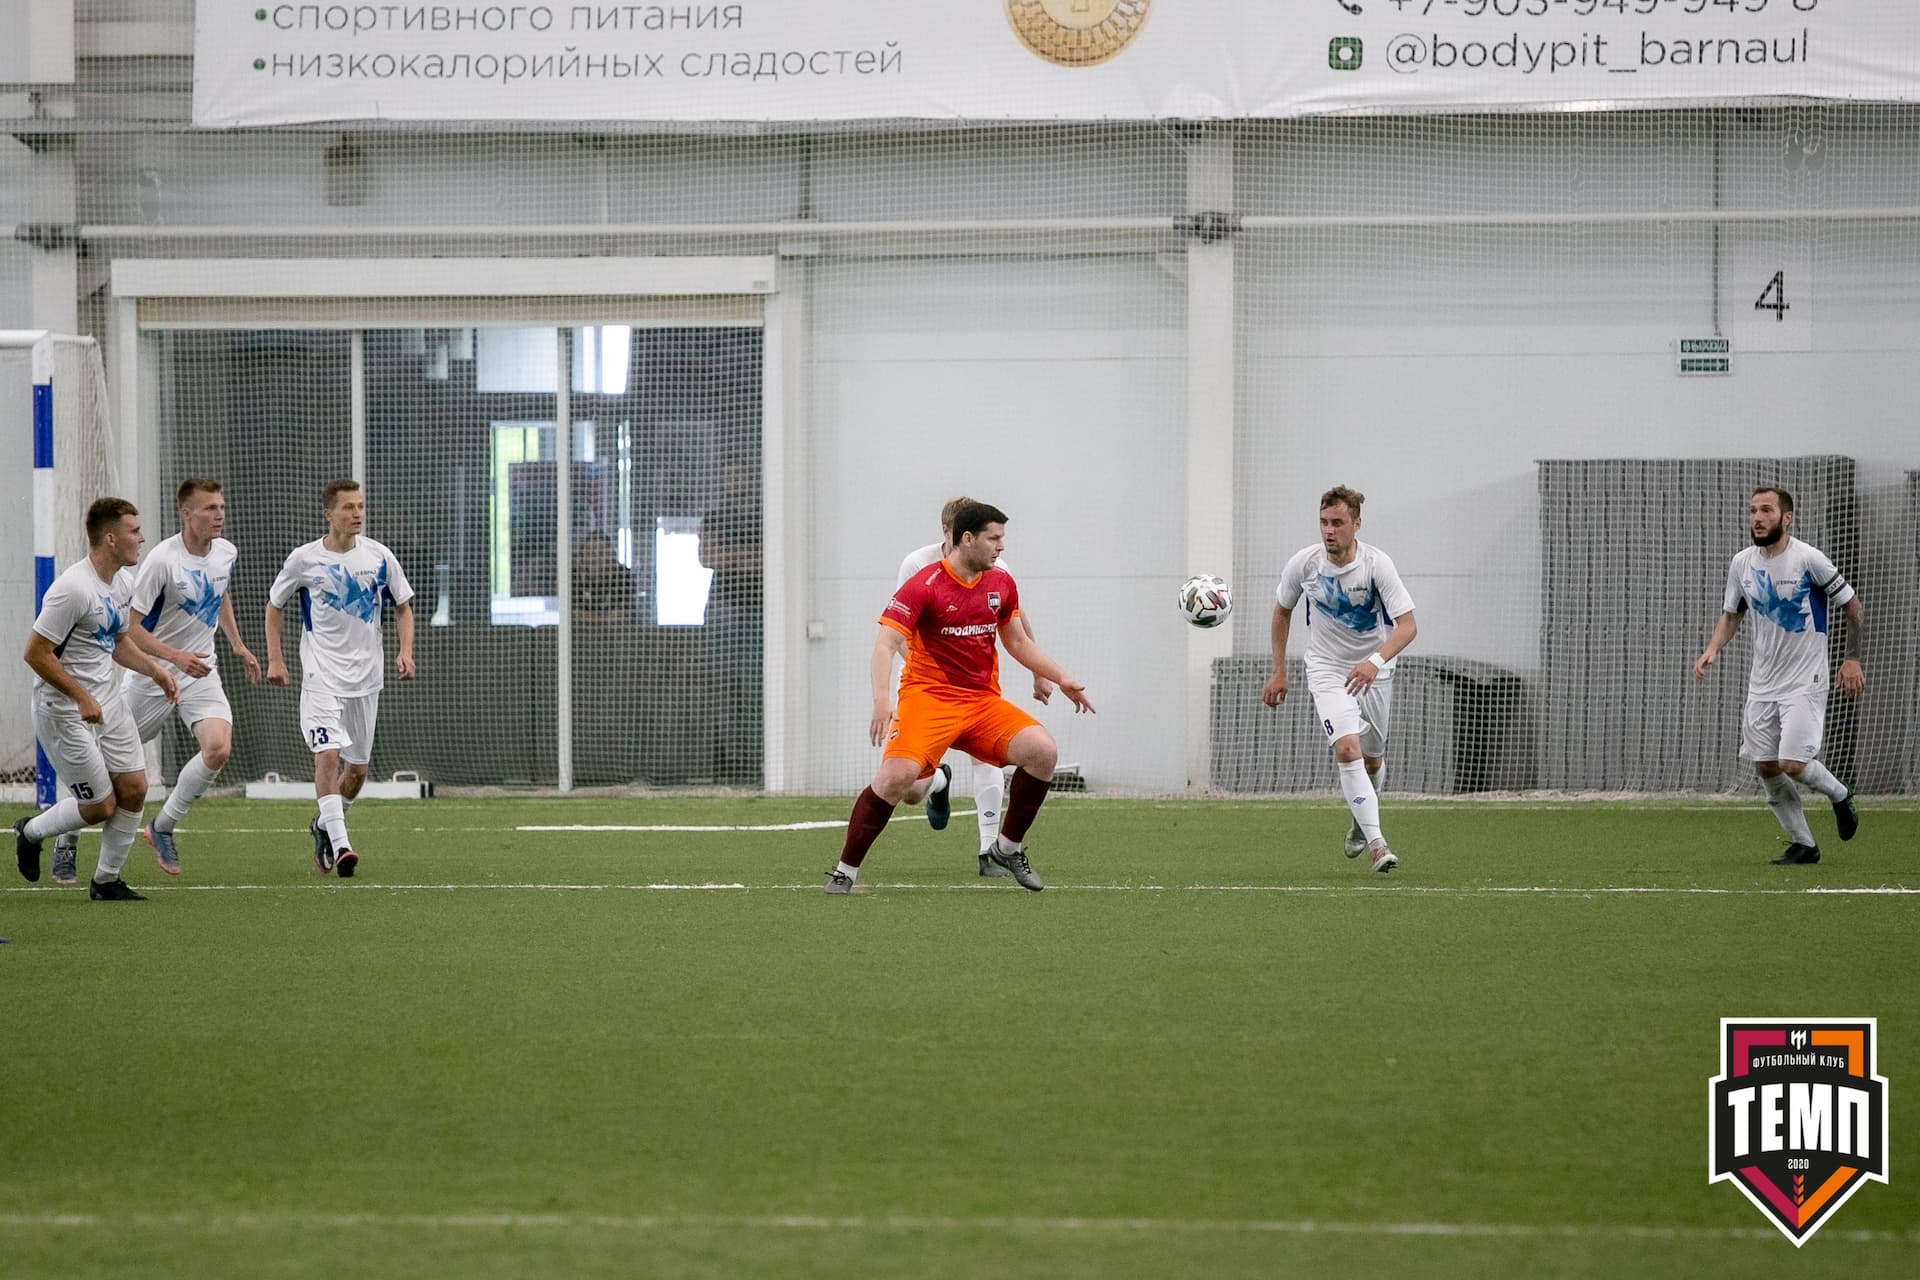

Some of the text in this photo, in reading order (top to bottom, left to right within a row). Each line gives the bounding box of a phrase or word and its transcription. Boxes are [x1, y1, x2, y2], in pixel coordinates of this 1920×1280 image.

[273, 4, 742, 36] спортивного питания
[272, 41, 902, 84] низкокалорийных сладостей
[1386, 28, 1808, 74] @bodypit_barnaul
[1754, 271, 1790, 321] 4
[1324, 719, 1334, 736] 8
[70, 782, 94, 800] 15
